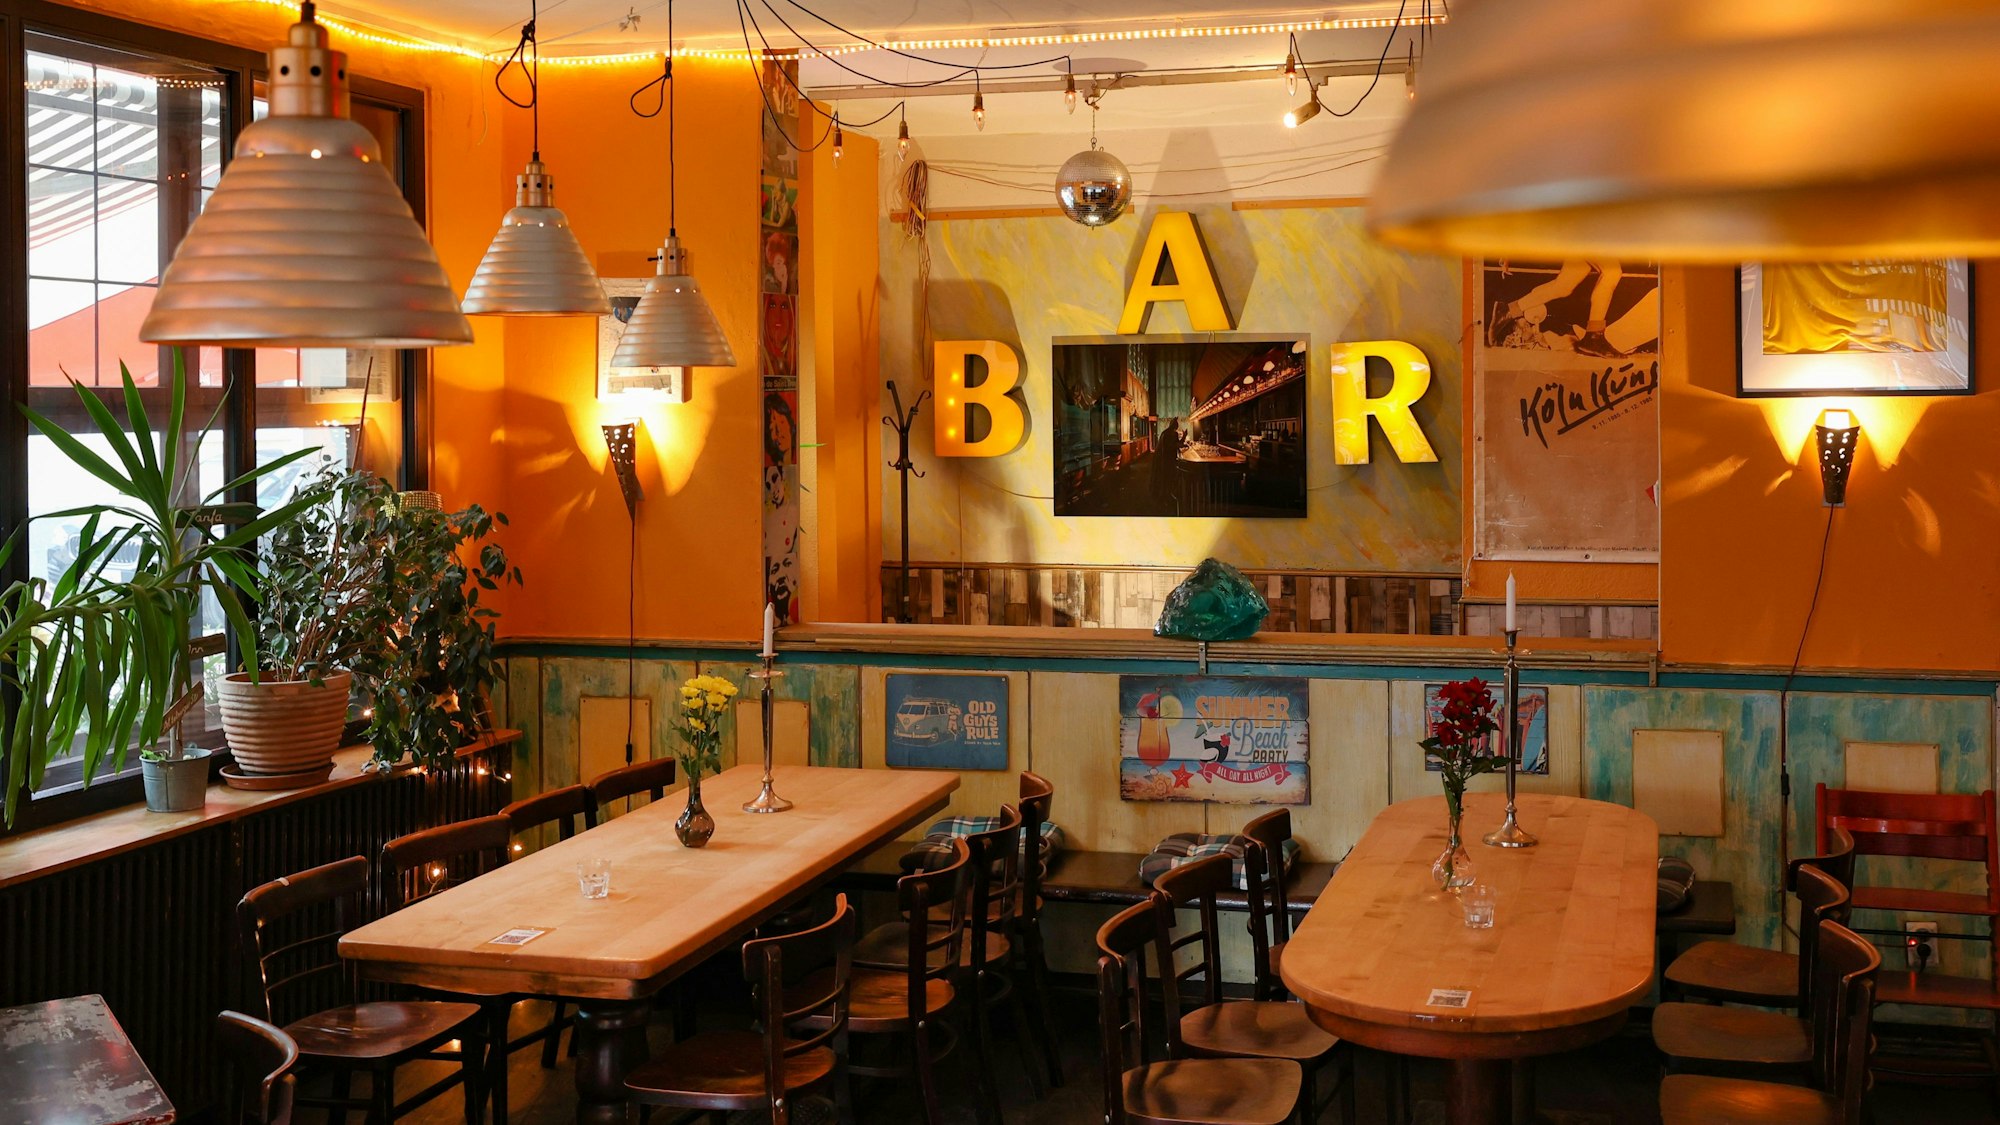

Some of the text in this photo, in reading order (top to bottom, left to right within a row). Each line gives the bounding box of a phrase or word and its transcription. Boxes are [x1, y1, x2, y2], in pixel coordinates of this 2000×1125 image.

[968, 700, 996, 714] OLD
[1195, 695, 1291, 728] SUMMER
[963, 713, 998, 727] GUYS
[965, 726, 999, 740] RULE
[1231, 717, 1288, 757] Beach
[1252, 749, 1289, 763] PARTY
[1216, 766, 1272, 782] ALL DAY ALL NIGHT
